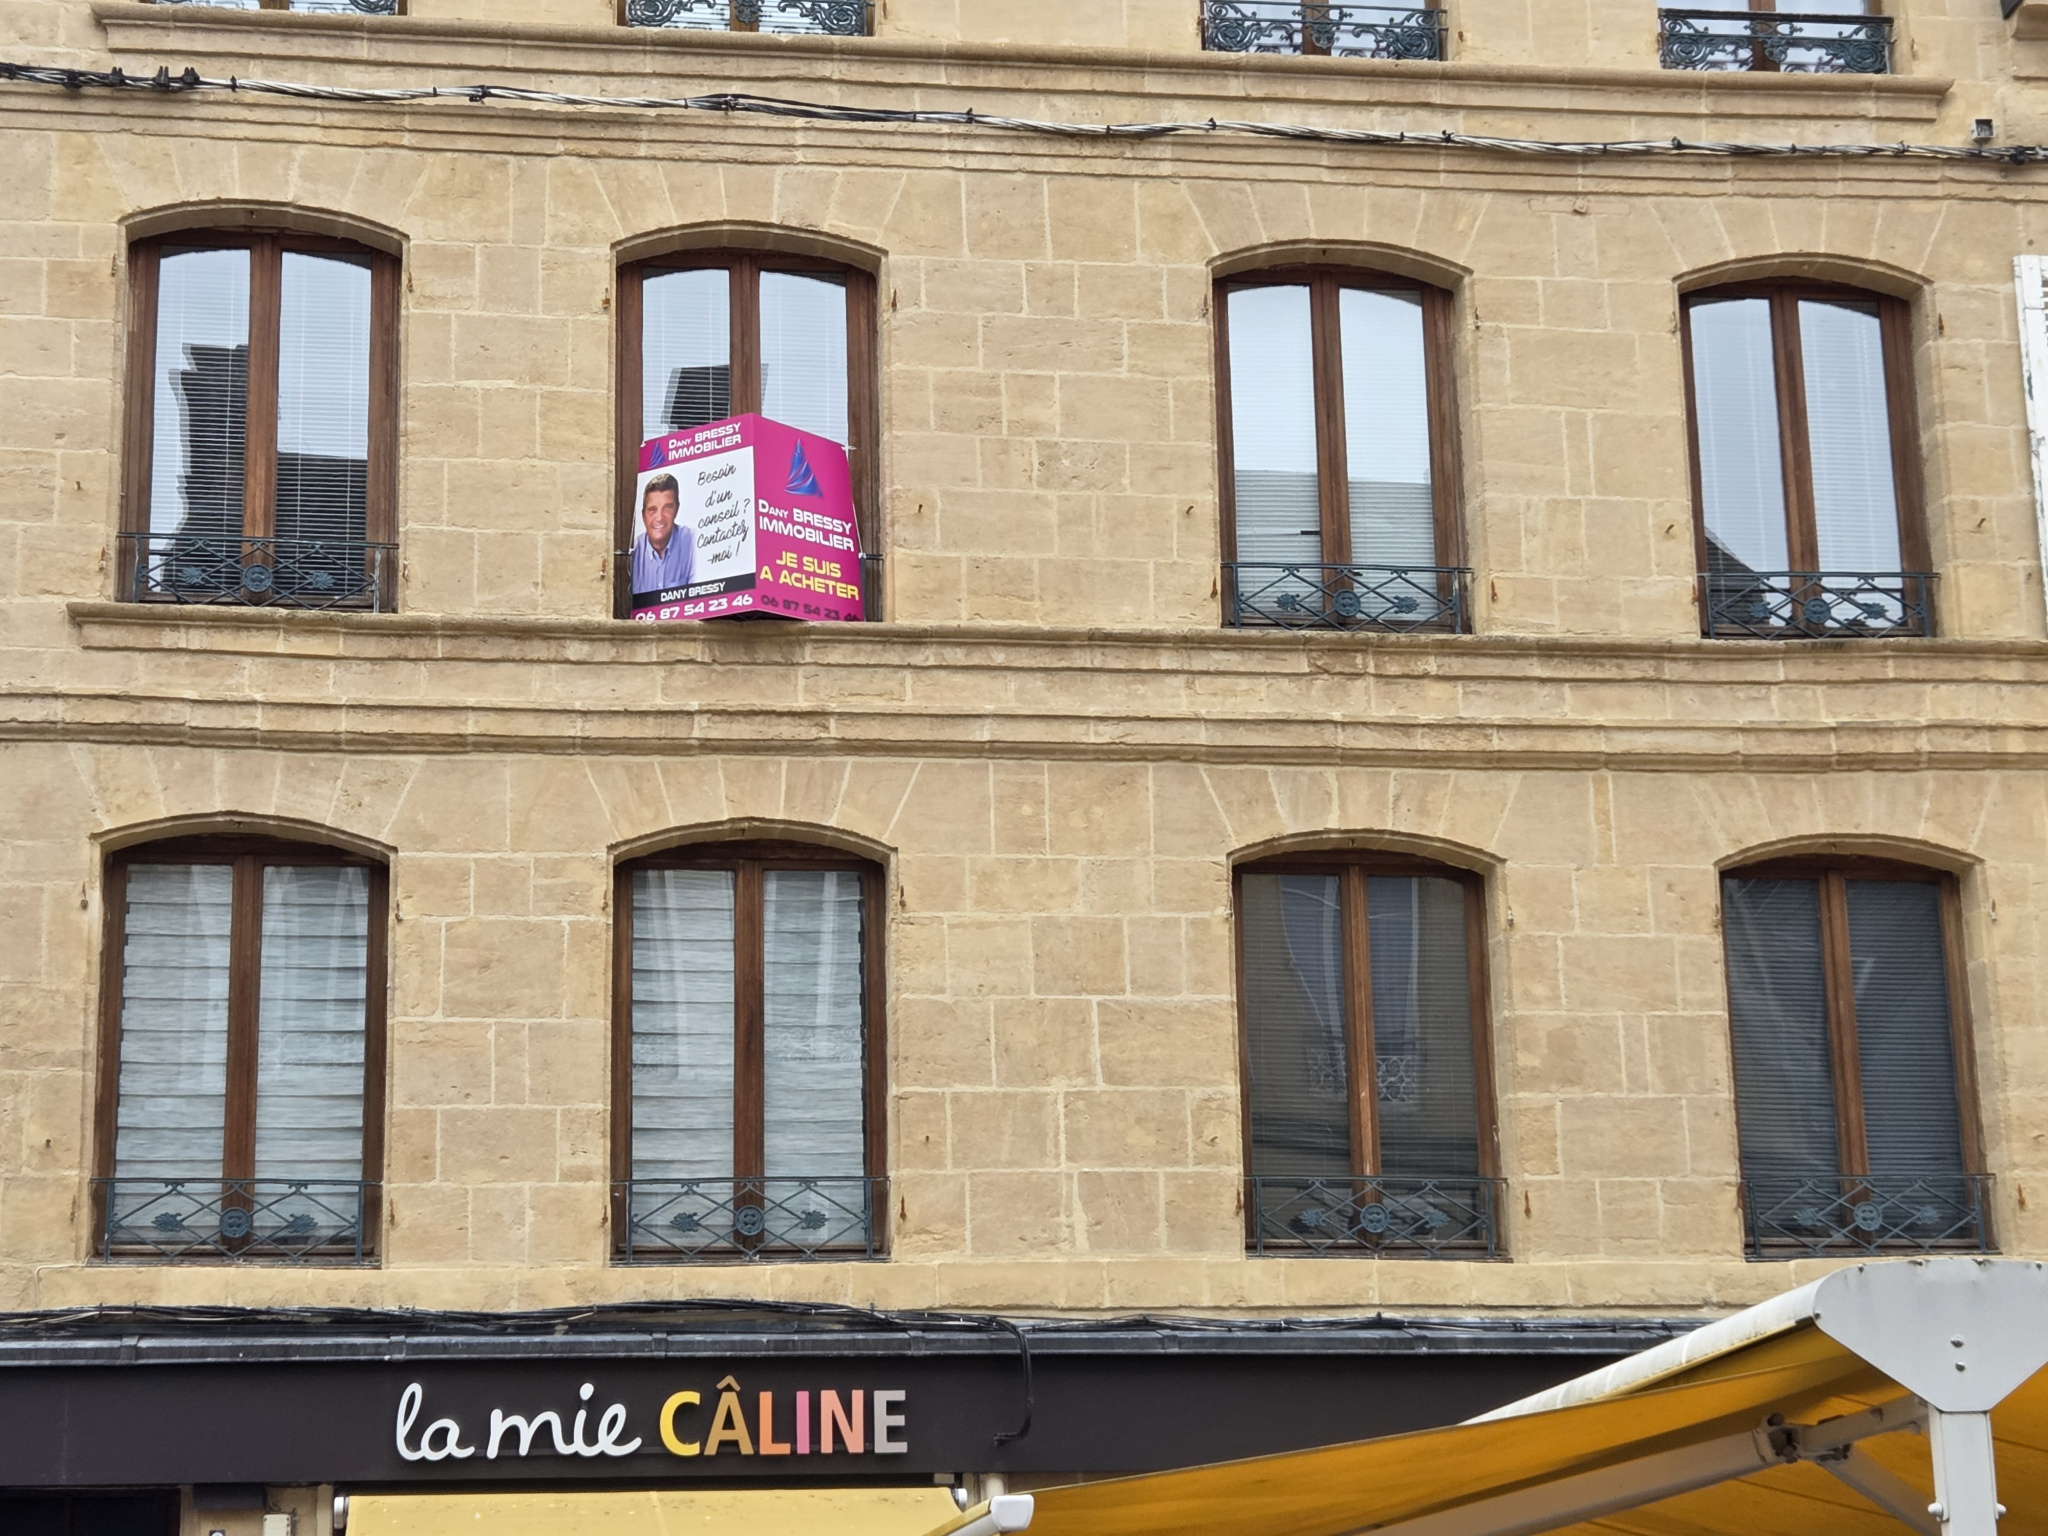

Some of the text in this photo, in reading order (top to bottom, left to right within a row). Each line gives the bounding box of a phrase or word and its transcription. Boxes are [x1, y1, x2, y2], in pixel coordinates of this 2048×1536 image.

[694, 422, 742, 442] BRESSY
[668, 434, 742, 461] IMMOBILIER
[697, 463, 736, 486] Besoin
[705, 490, 733, 508] d'un
[698, 500, 739, 529] conseil
[792, 507, 852, 535] BRESSY
[697, 519, 749, 549] Contactez
[759, 515, 854, 552] IMMOBILIER
[776, 550, 842, 578] JE SUIS
[660, 581, 725, 602] DANY BRESSY
[760, 565, 859, 601] A ACHETER
[635, 594, 753, 622] 06 87 54 23 46
[761, 594, 779, 608] 06
[782, 599, 799, 612] 87
[803, 603, 821, 616] 54
[824, 607, 840, 620] 23
[396, 1375, 908, 1461] la mie CÂLINE
